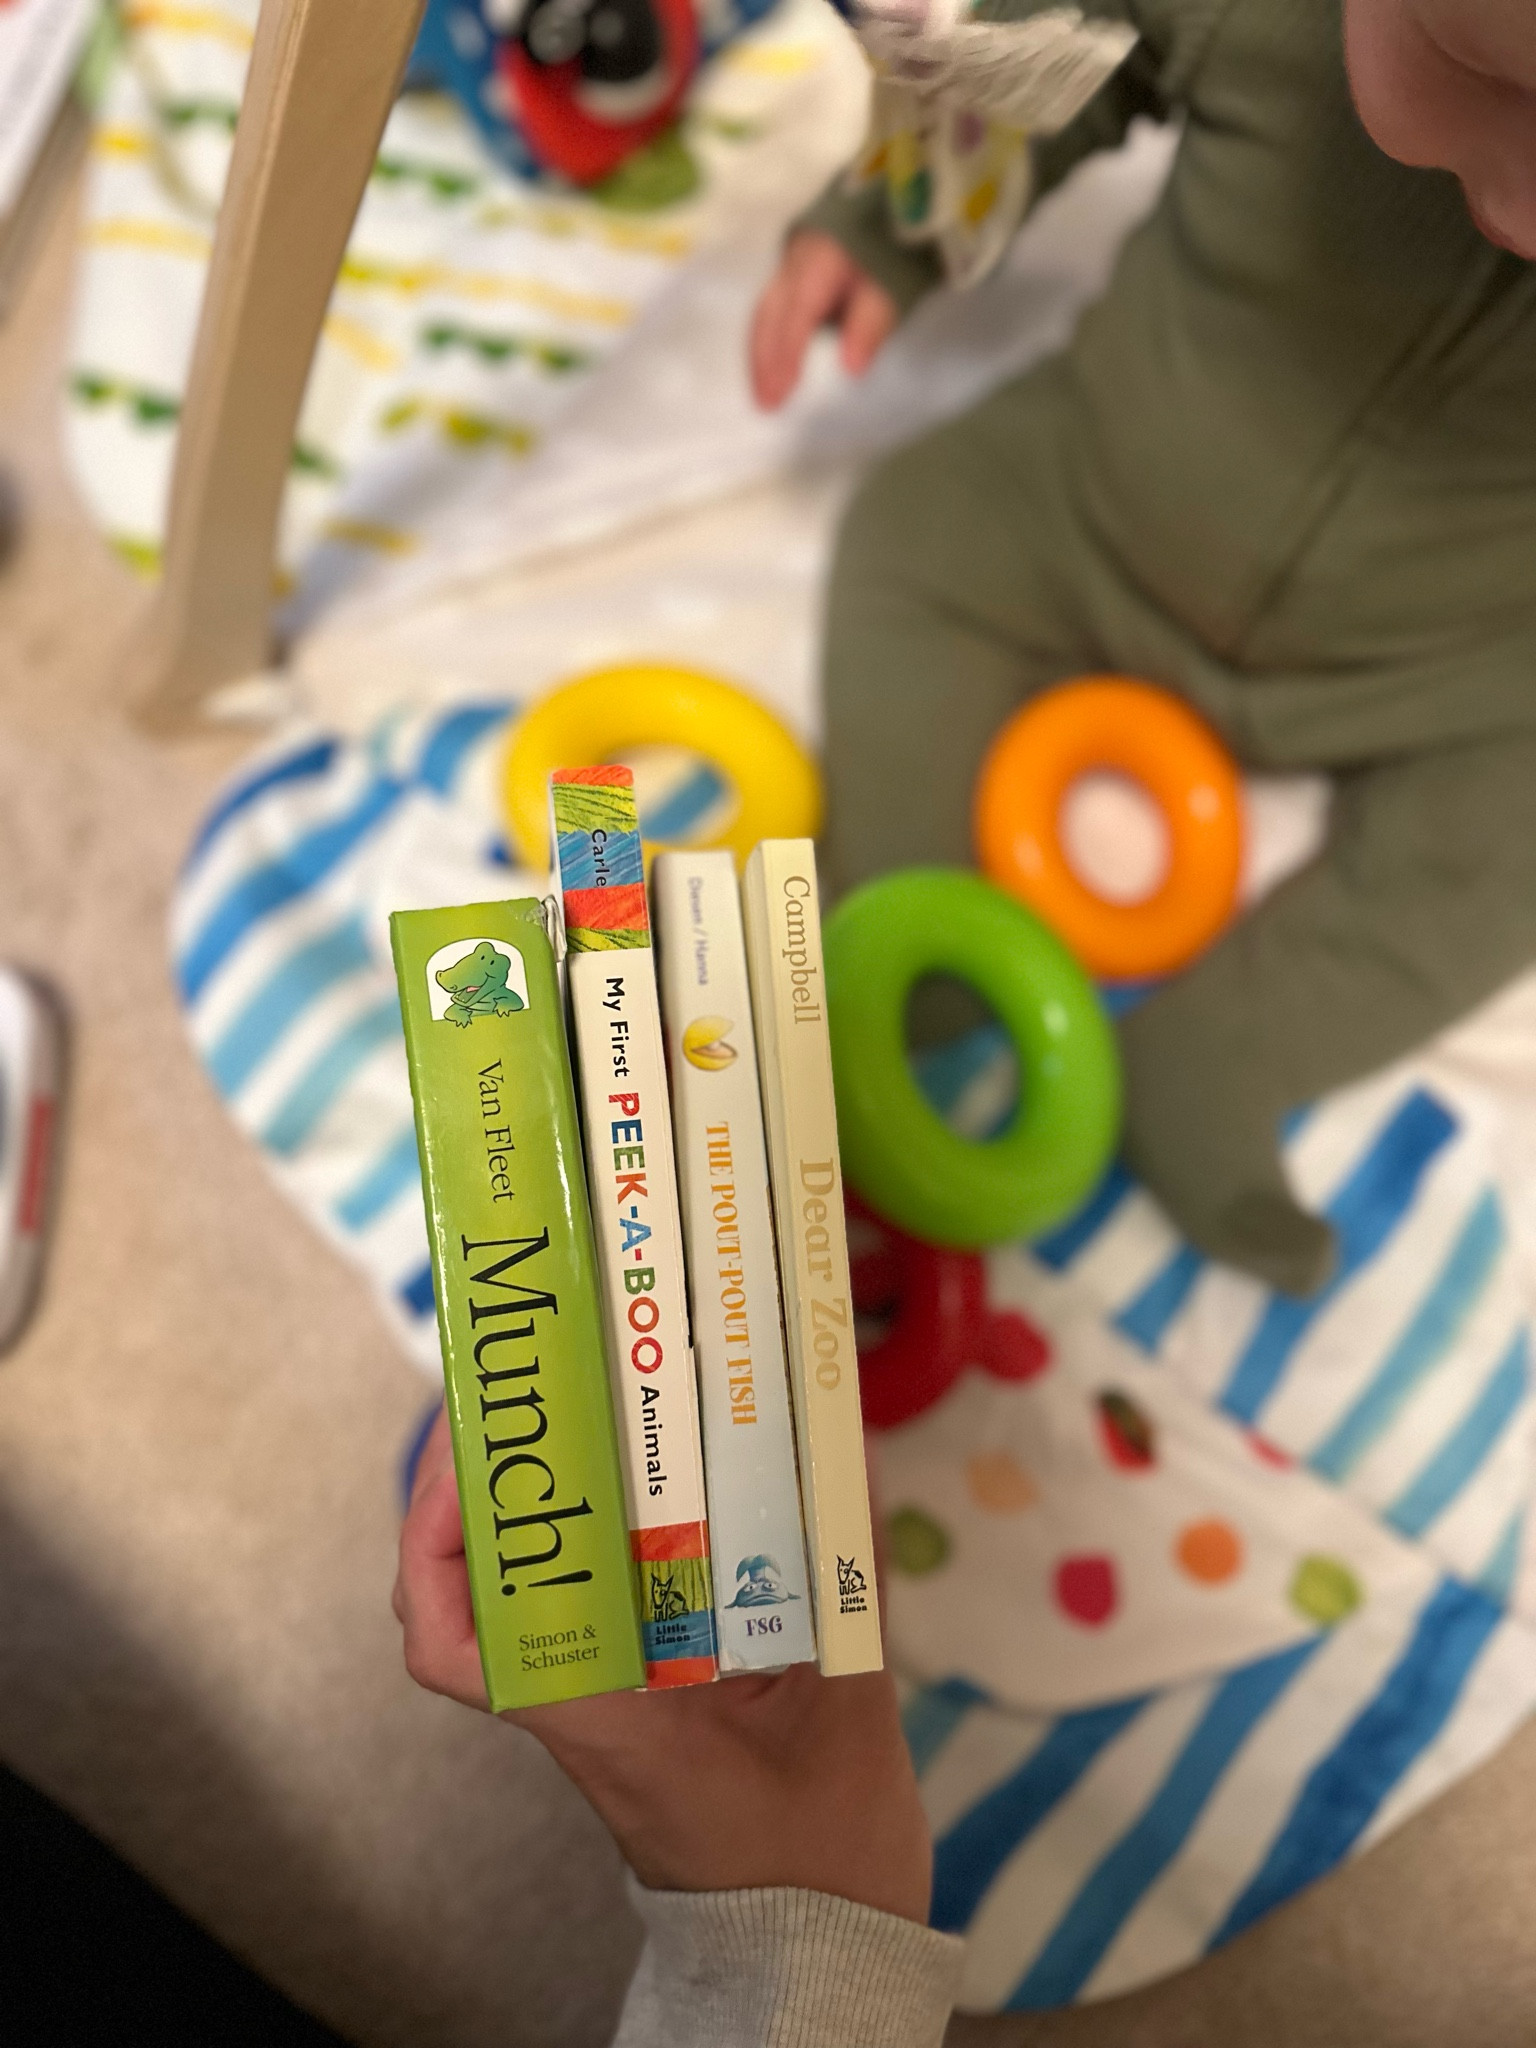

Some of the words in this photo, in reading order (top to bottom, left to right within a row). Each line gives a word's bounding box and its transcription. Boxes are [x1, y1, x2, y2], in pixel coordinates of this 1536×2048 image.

[591, 828, 608, 888] Carle
[782, 875, 822, 1025] Campbell
[603, 976, 625, 1012] My
[609, 1019, 630, 1078] First
[477, 1058, 504, 1119] Van
[484, 1125, 516, 1204] Fleet
[705, 1120, 734, 1177] THE
[608, 1092, 664, 1374] PEEK-A-BOO
[799, 1158, 834, 1282] Dear
[710, 1179, 750, 1348] POUT-POUT
[811, 1297, 848, 1391] Zoo
[461, 1226, 594, 1596] Munch!
[726, 1356, 758, 1425] FISH
[640, 1385, 668, 1497] Animals
[656, 1623, 688, 1635] Little
[745, 1614, 784, 1637] FSG
[839, 1604, 868, 1614] Simon
[840, 1596, 866, 1606] Little
[519, 1627, 579, 1652] Simon
[582, 1624, 597, 1640] &
[521, 1645, 601, 1672] Schuster
[655, 1632, 691, 1646] Simon
